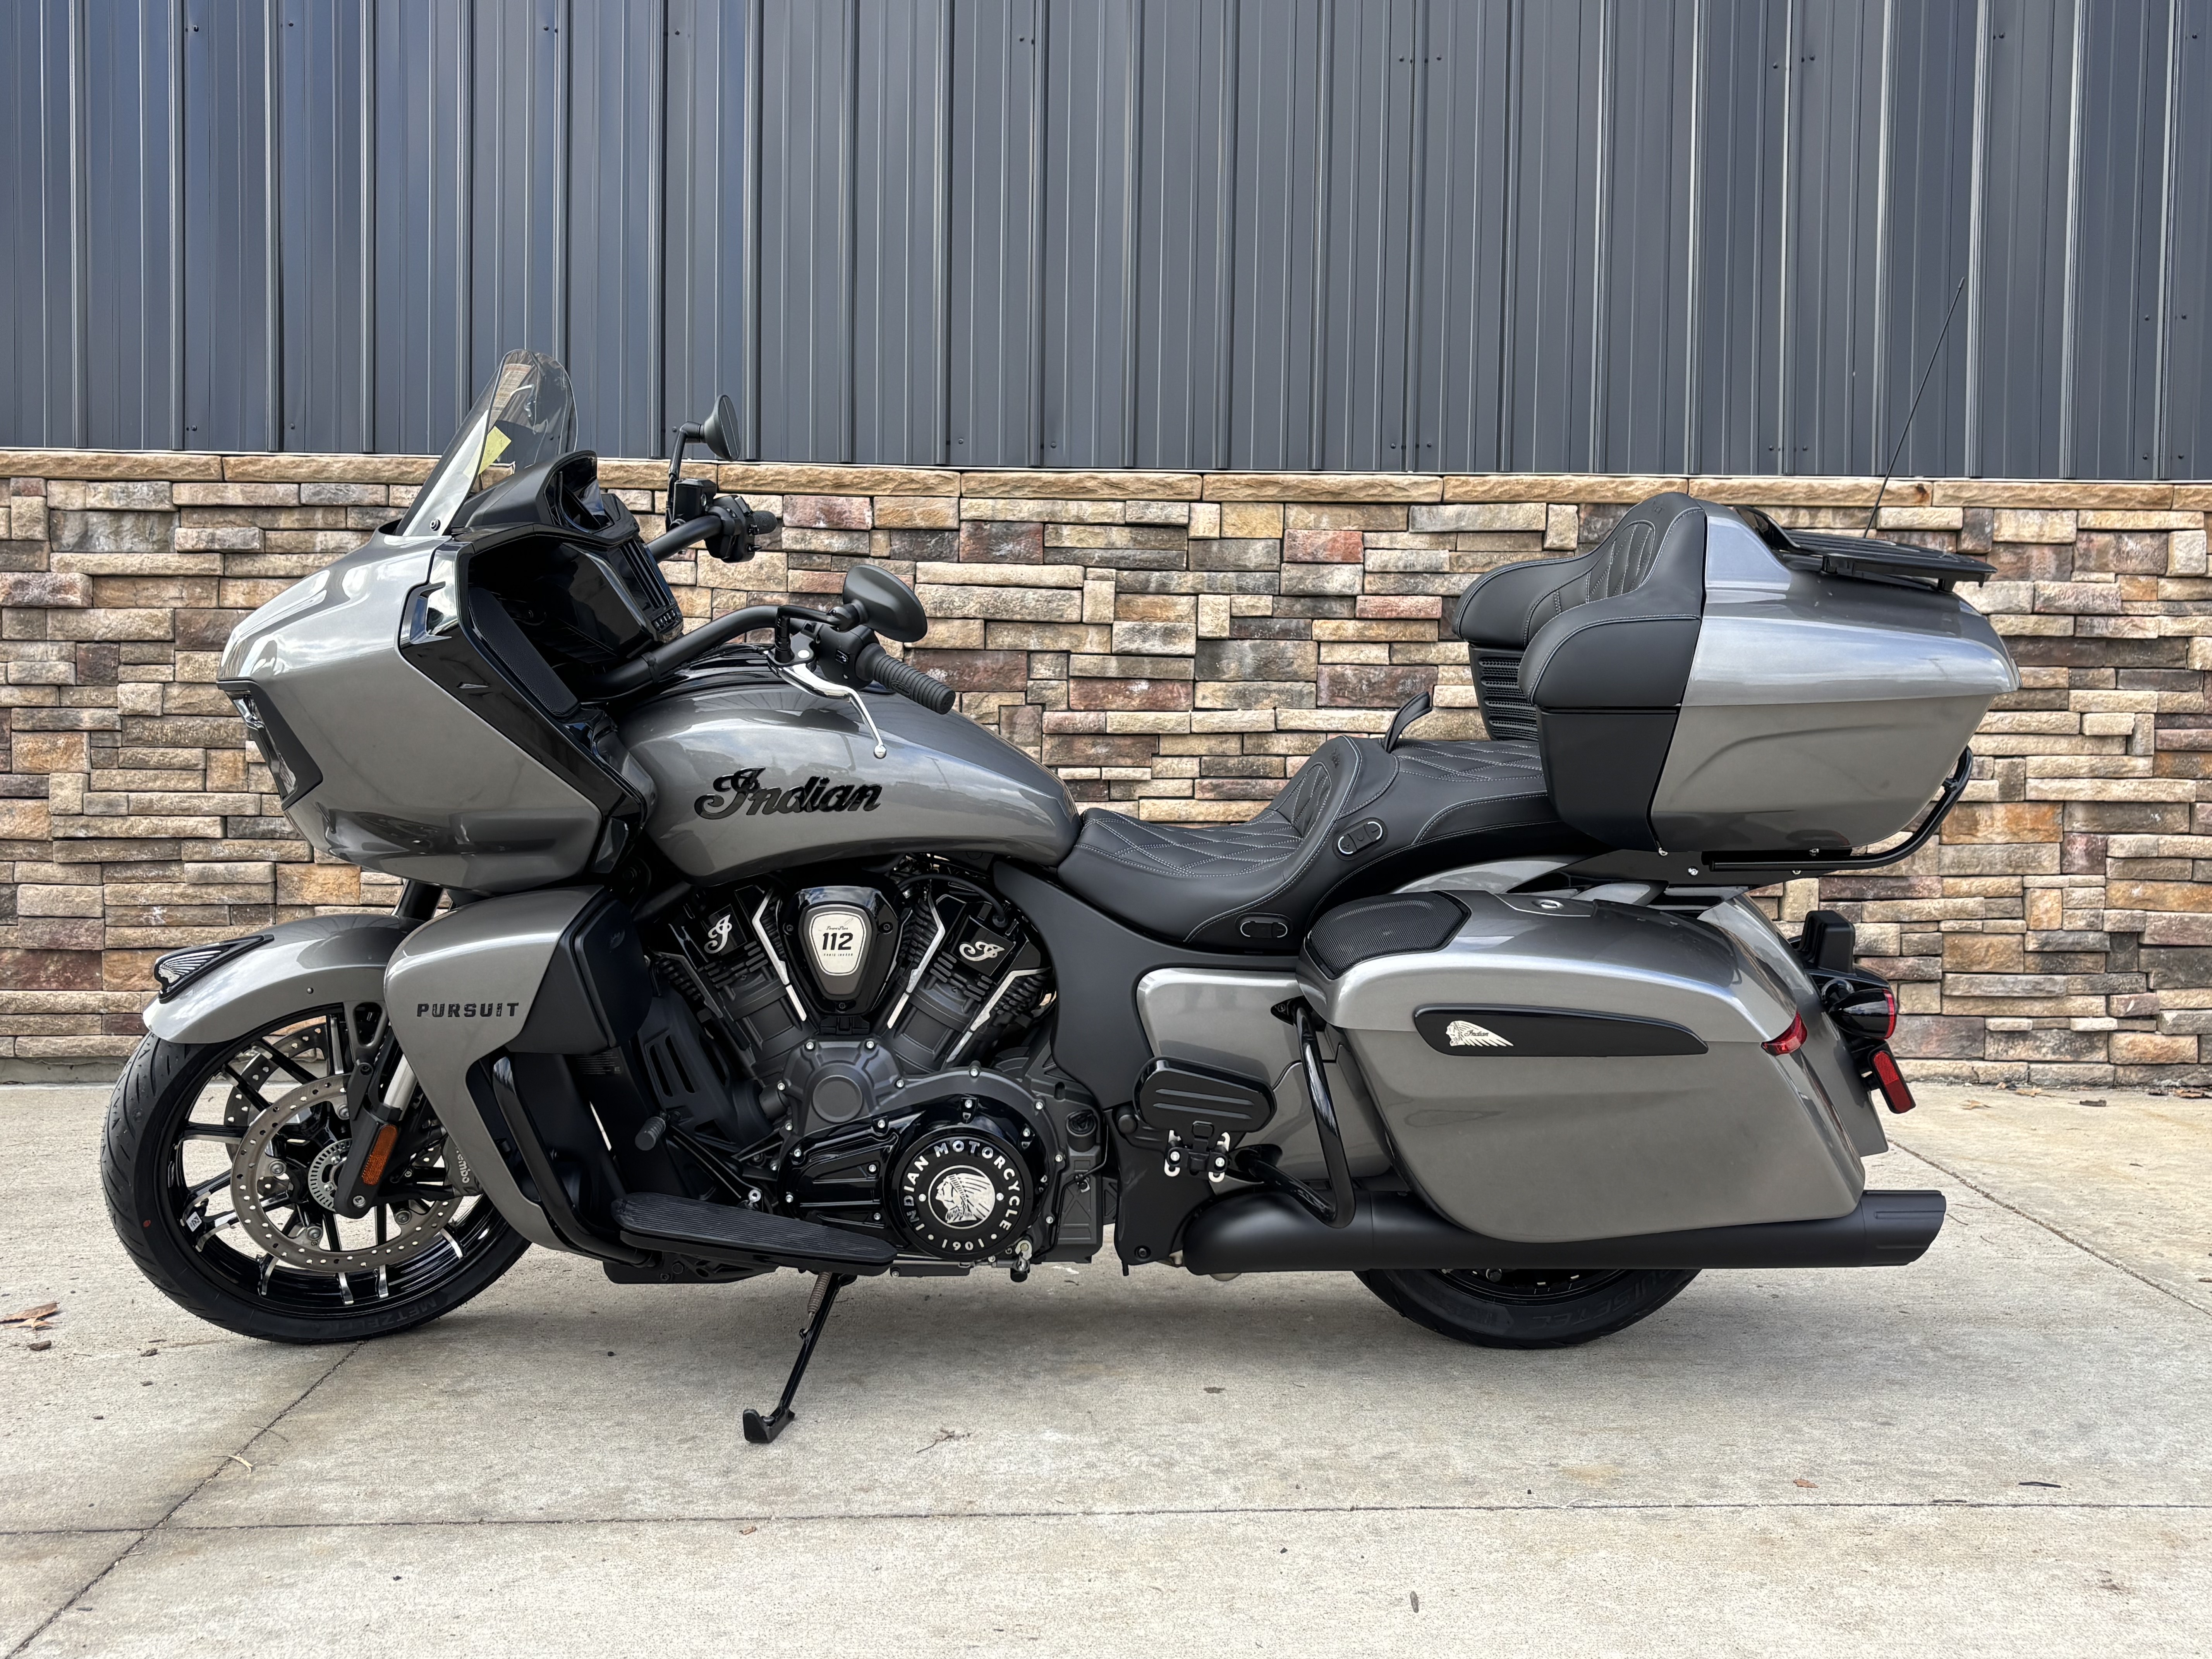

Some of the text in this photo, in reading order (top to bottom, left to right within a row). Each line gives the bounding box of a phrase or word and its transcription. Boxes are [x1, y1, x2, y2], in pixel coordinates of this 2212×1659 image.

[694, 766, 882, 820] Indian
[823, 933, 853, 950] 112
[417, 1003, 519, 1017] PURSUIT
[455, 1147, 471, 1183] embo
[904, 1140, 1020, 1231] INDIAN MOTORCYCLE
[942, 1238, 984, 1251] 1901
